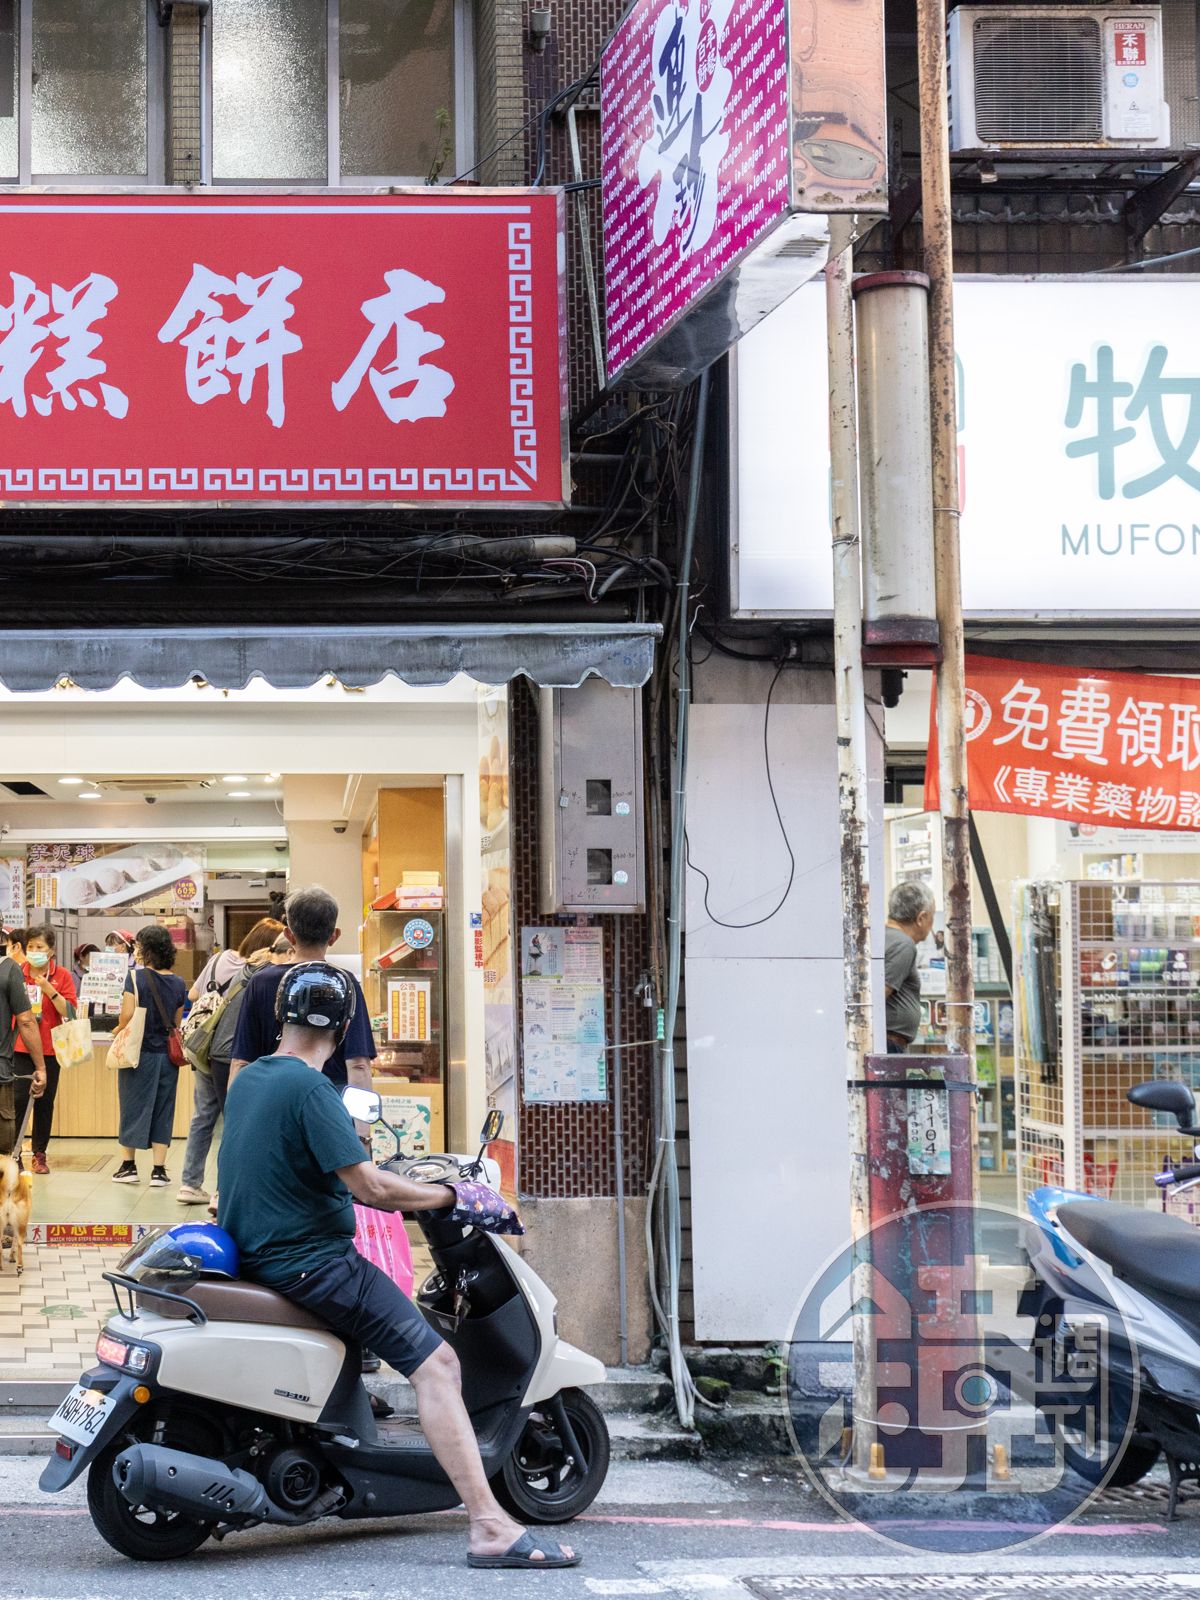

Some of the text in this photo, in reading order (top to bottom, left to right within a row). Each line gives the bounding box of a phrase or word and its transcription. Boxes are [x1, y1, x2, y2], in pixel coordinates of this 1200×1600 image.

[1122, 34, 1139, 61] 禾聯
[992, 678, 1200, 772] 免費領取
[30, 844, 97, 860] 芋泥球
[50, 1225, 129, 1236] 小心台階
